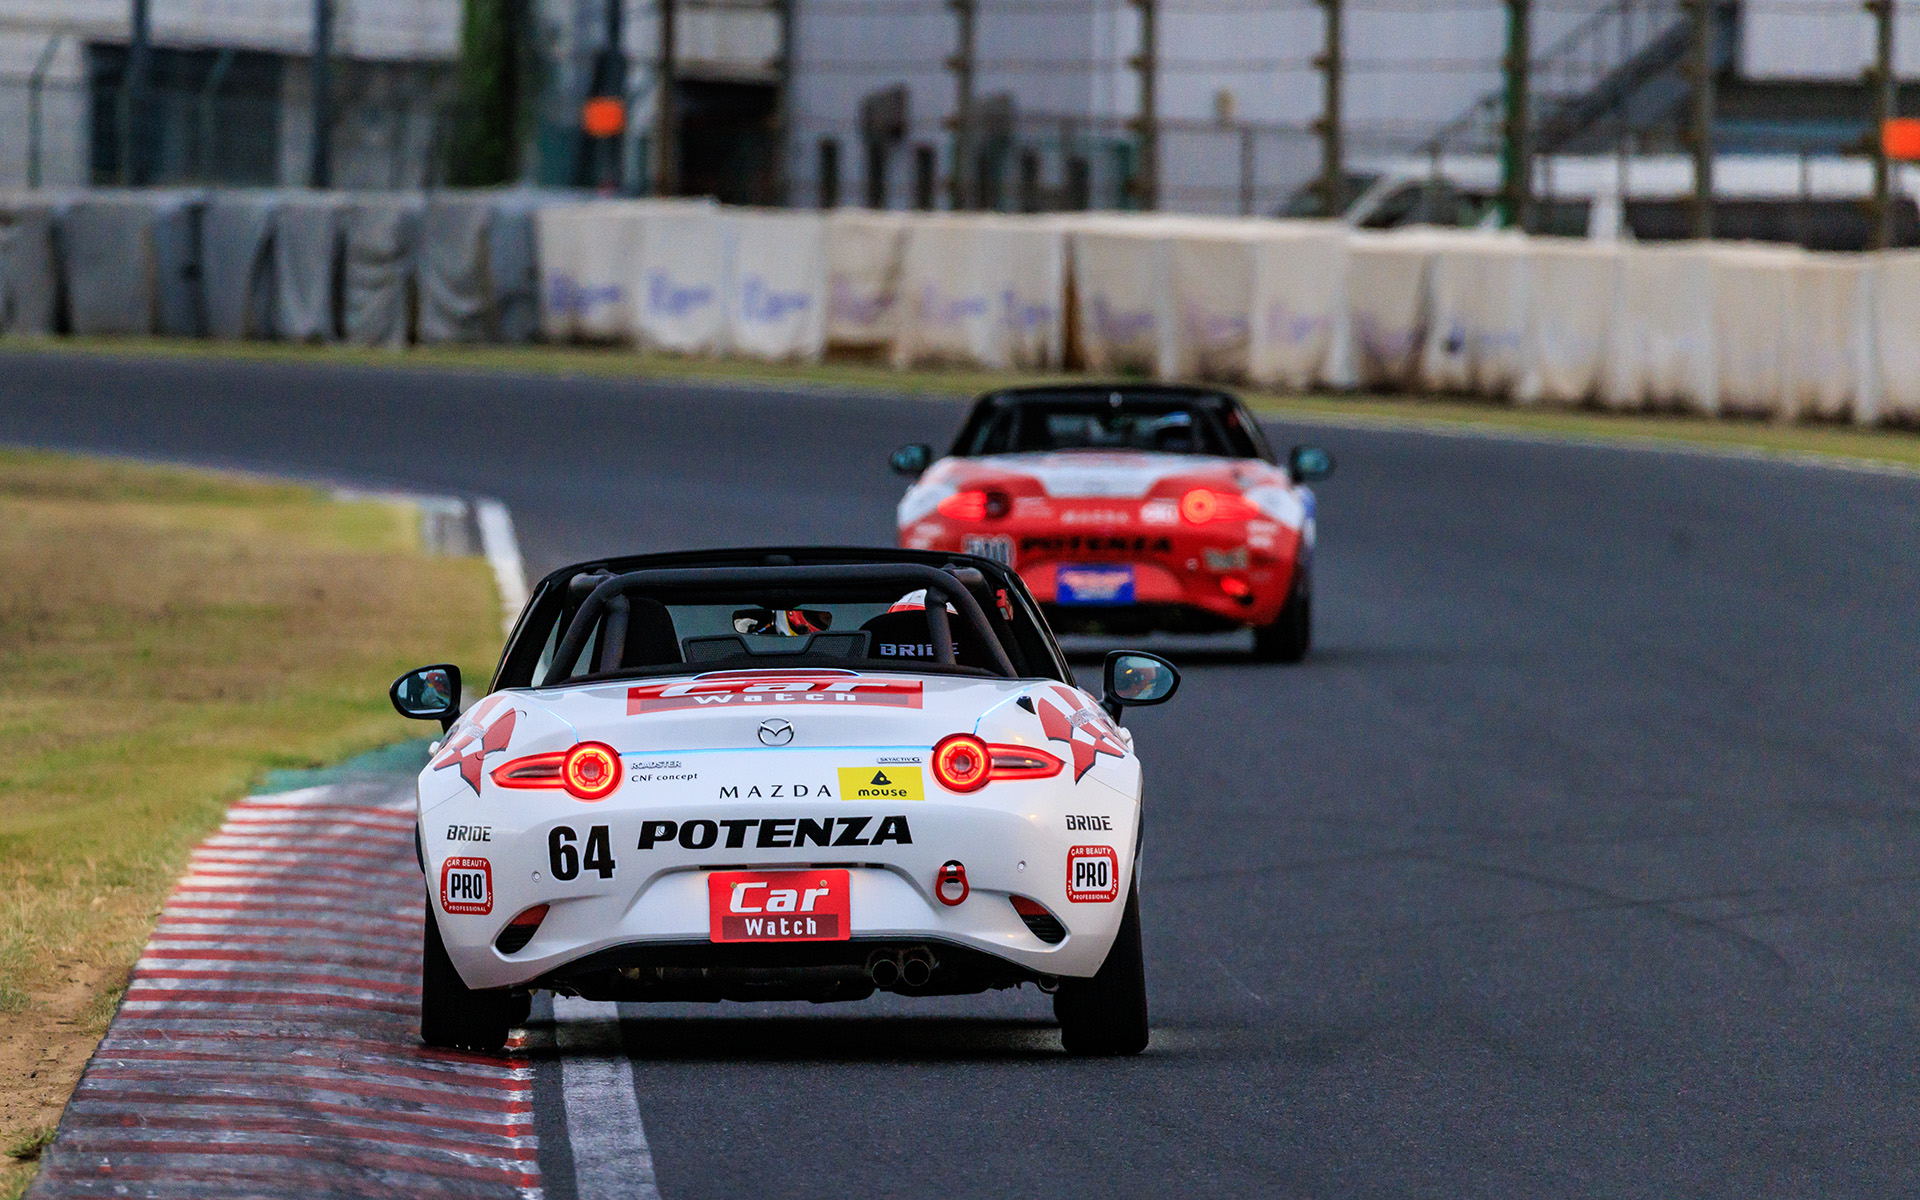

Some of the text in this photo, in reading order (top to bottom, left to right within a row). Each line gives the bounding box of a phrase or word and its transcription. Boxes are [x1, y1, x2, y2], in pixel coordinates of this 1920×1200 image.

[659, 681, 889, 697] Car
[693, 693, 857, 705] Watch
[631, 761, 681, 770] ROADSTER
[631, 773, 698, 783] CNF concept
[719, 784, 832, 800] MAZDA
[858, 788, 907, 797] mouse
[1065, 815, 1113, 831] BRIDE
[446, 825, 492, 842] BRIDE
[637, 815, 913, 850] POTENZA
[548, 825, 616, 881] 64
[1071, 847, 1084, 856] CAR
[446, 859, 488, 867] CAR BEAUTY
[1076, 861, 1107, 887] PRO
[451, 873, 483, 899] PRO
[729, 881, 829, 913] Car
[745, 917, 817, 936] Watch
